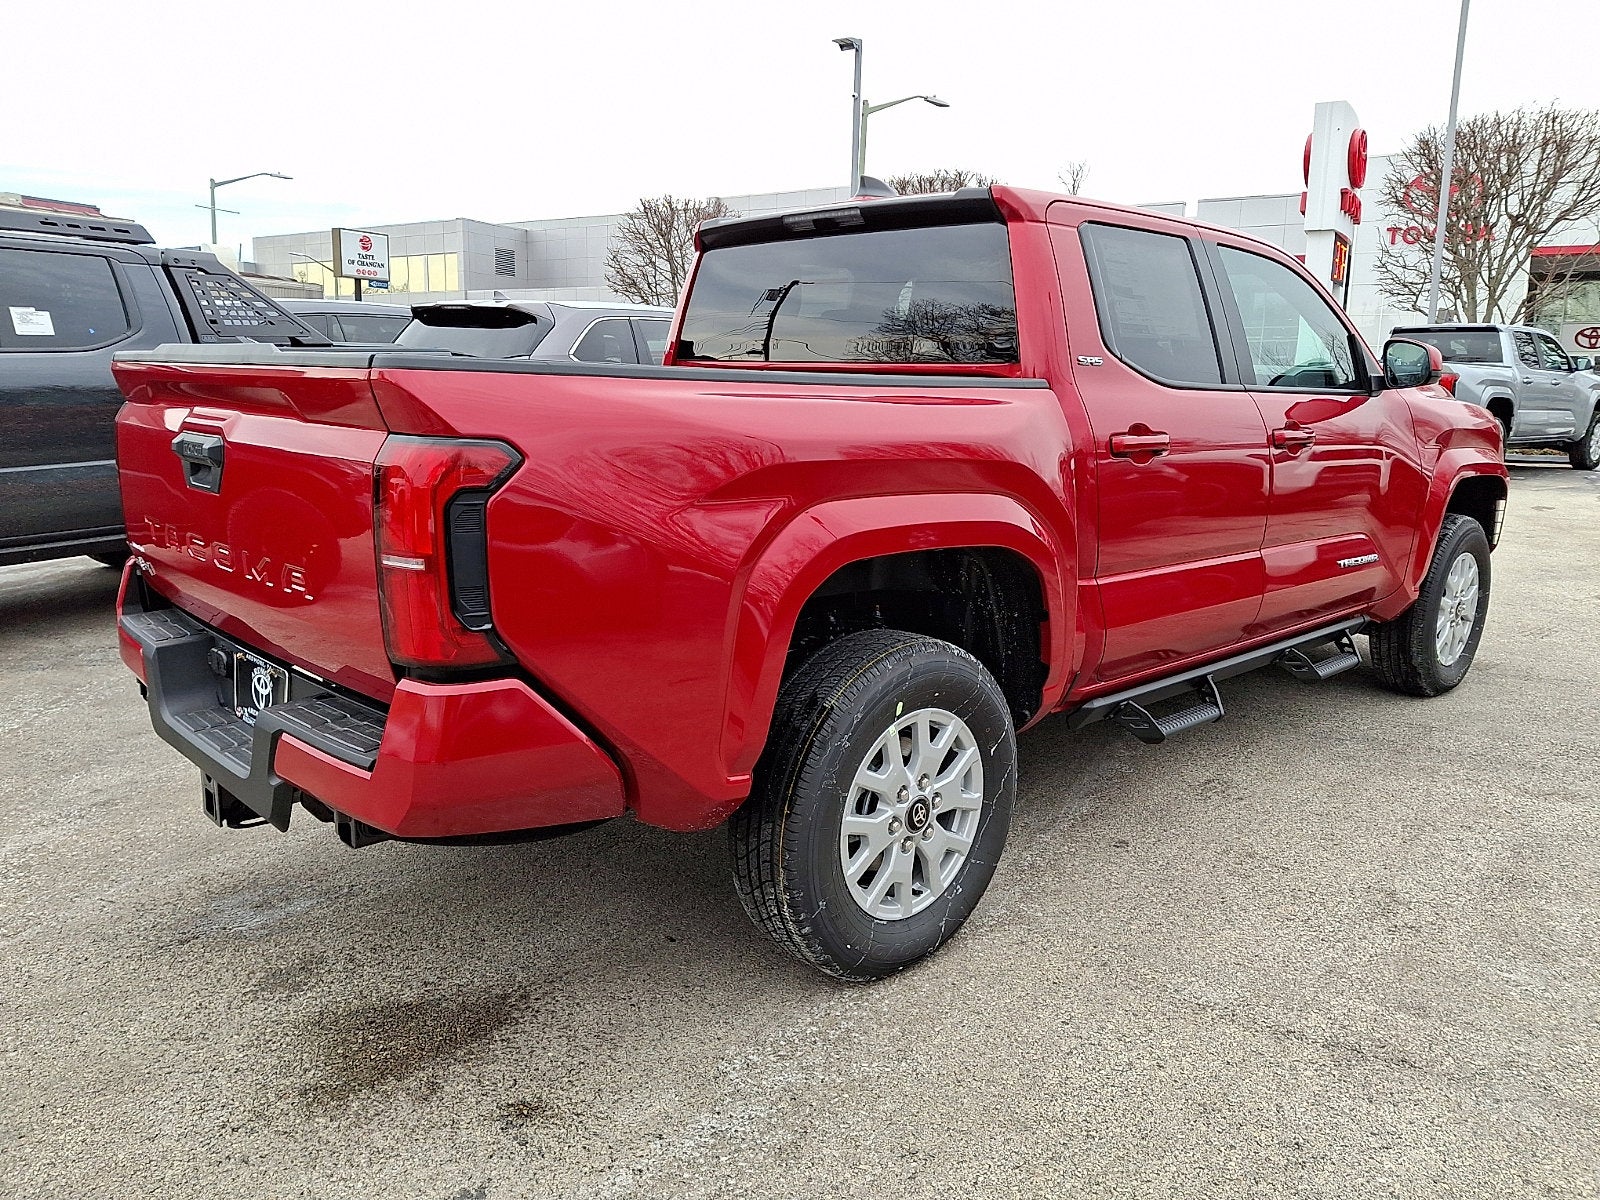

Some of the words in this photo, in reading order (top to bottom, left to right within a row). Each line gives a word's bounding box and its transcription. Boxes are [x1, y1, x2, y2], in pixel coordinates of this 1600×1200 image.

[1387, 226, 1495, 245] TOA
[1077, 355, 1103, 366] SR5
[144, 515, 314, 600] TACOMA
[1336, 553, 1379, 568] TACOMA
